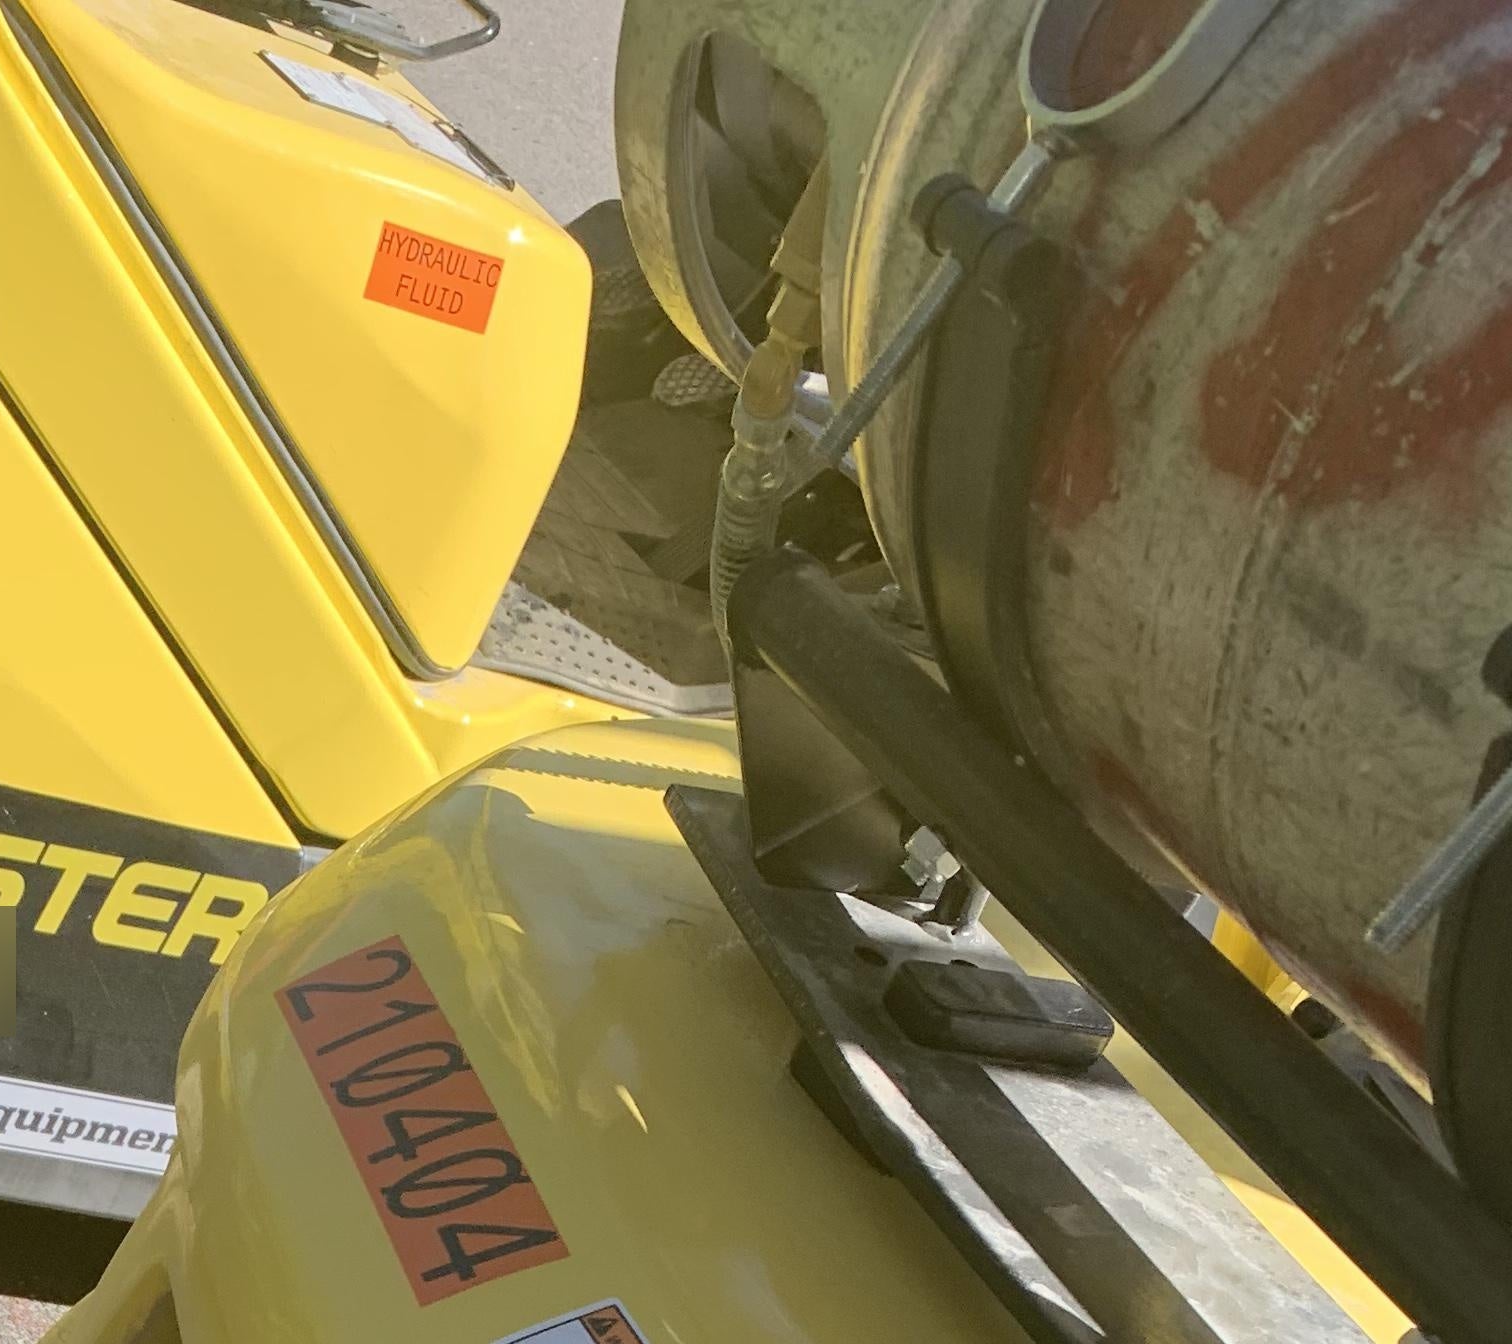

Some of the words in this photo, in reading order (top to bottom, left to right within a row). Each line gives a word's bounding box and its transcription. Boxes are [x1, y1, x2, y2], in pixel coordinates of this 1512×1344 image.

[377, 227, 502, 288] HYDRAULIC
[395, 274, 464, 314] FLUID
[284, 948, 562, 1283] 210404
